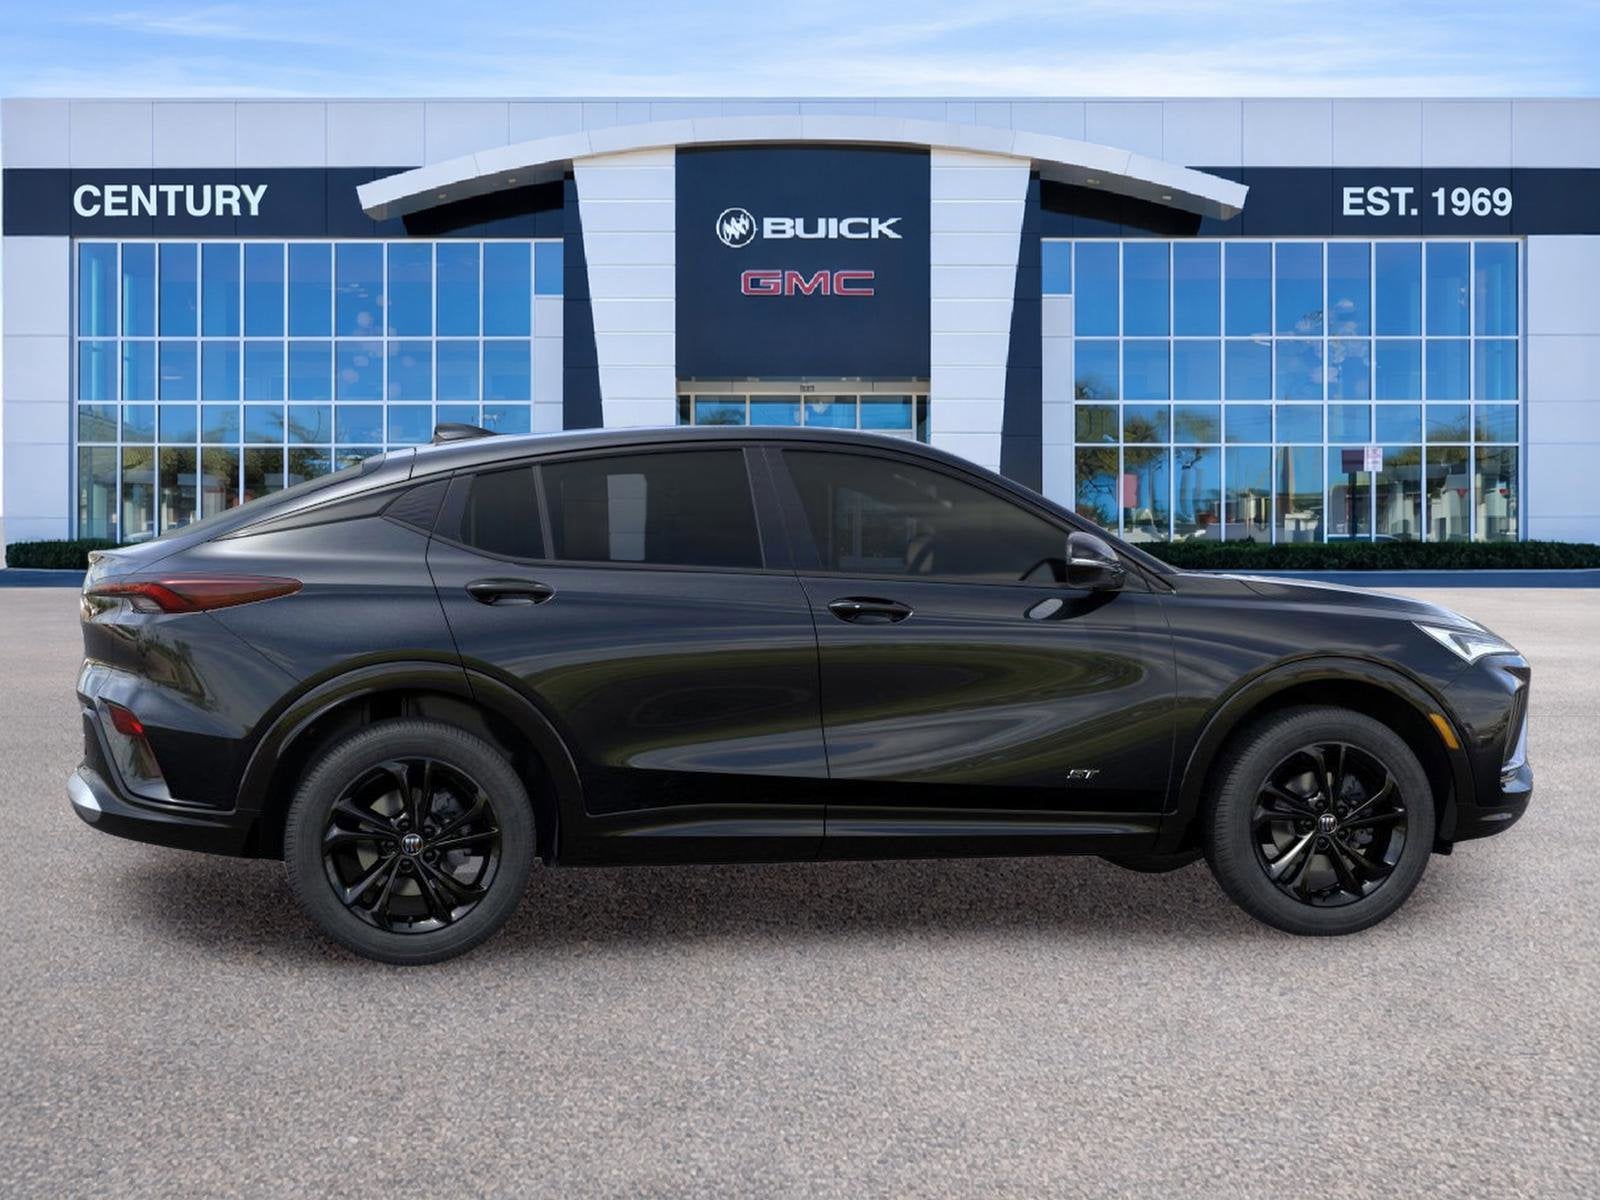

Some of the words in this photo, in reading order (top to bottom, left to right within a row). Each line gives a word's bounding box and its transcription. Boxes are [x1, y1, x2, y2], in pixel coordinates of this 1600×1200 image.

[73, 184, 268, 217] CENTURY
[1343, 186, 1418, 216] EST.
[1431, 187, 1513, 217] 1969
[762, 217, 903, 239] BUICK
[740, 269, 875, 296] GMC
